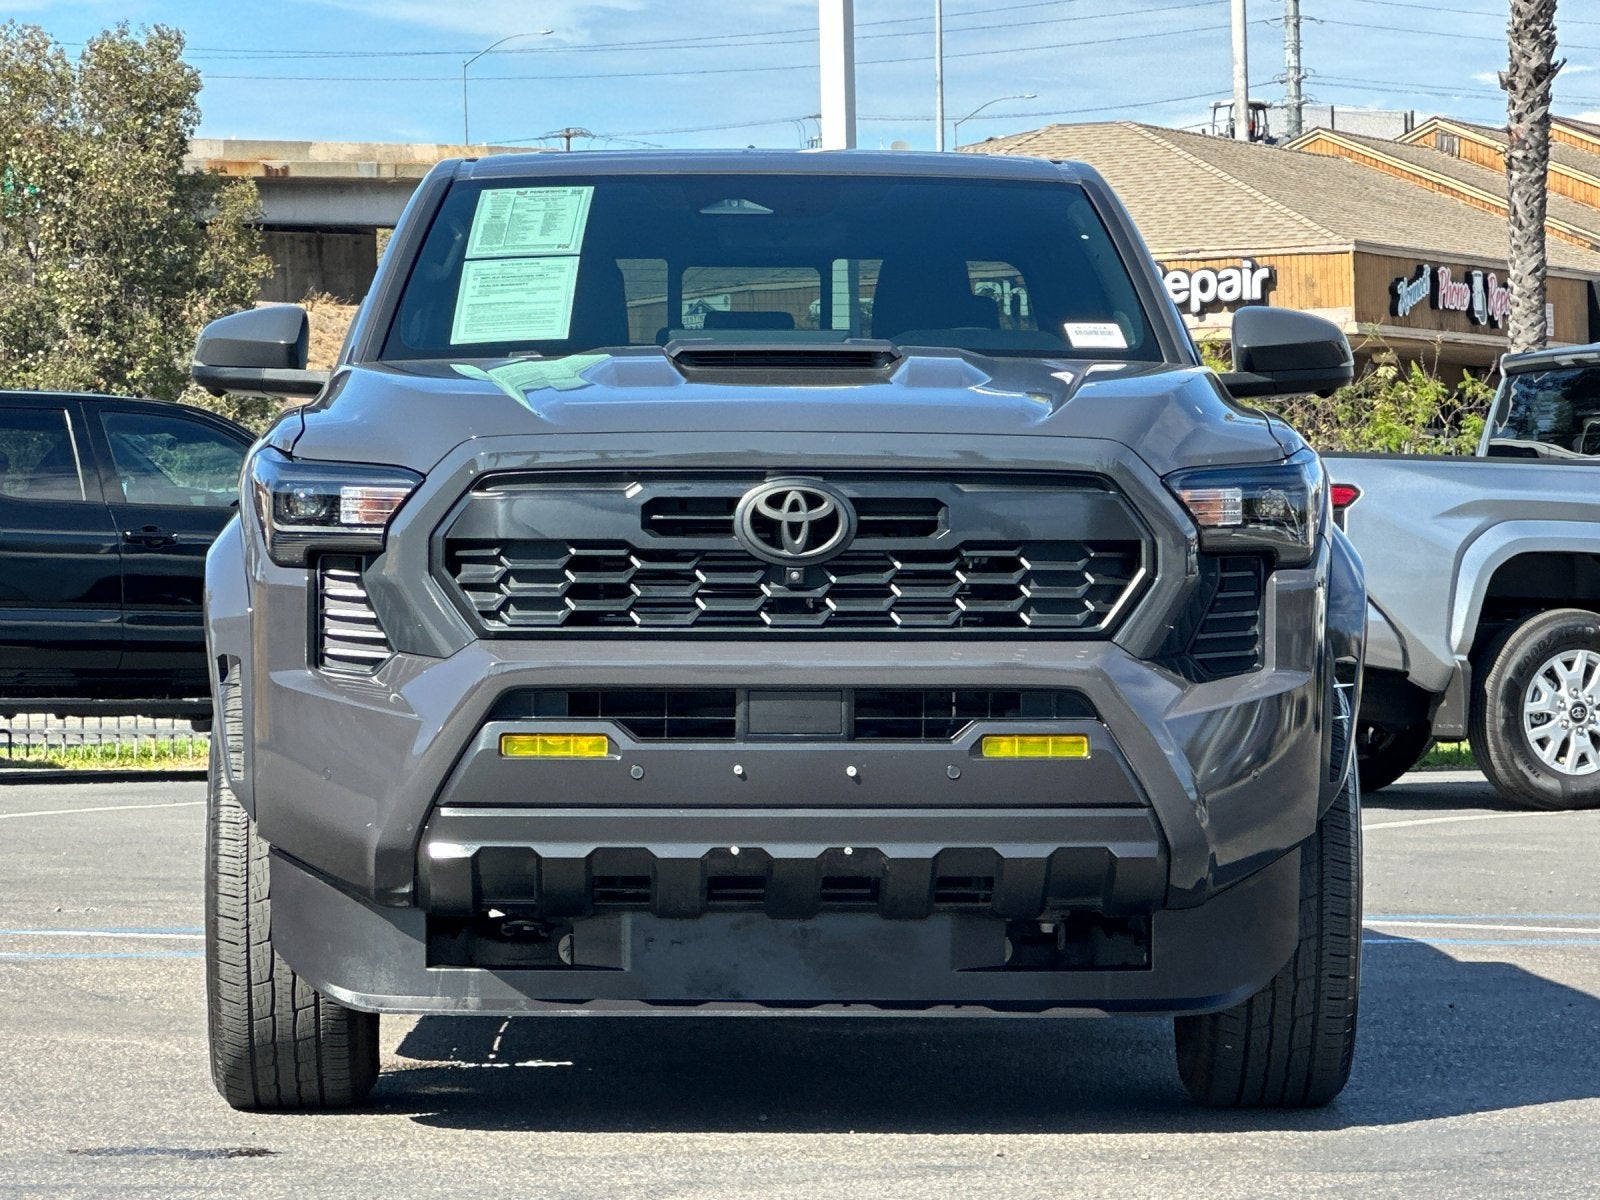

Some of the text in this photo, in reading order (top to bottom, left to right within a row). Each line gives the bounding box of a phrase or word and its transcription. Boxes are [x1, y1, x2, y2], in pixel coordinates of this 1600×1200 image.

[1156, 260, 1270, 313] epair
[1438, 266, 1471, 311] Phone
[1488, 272, 1512, 329] Repa
